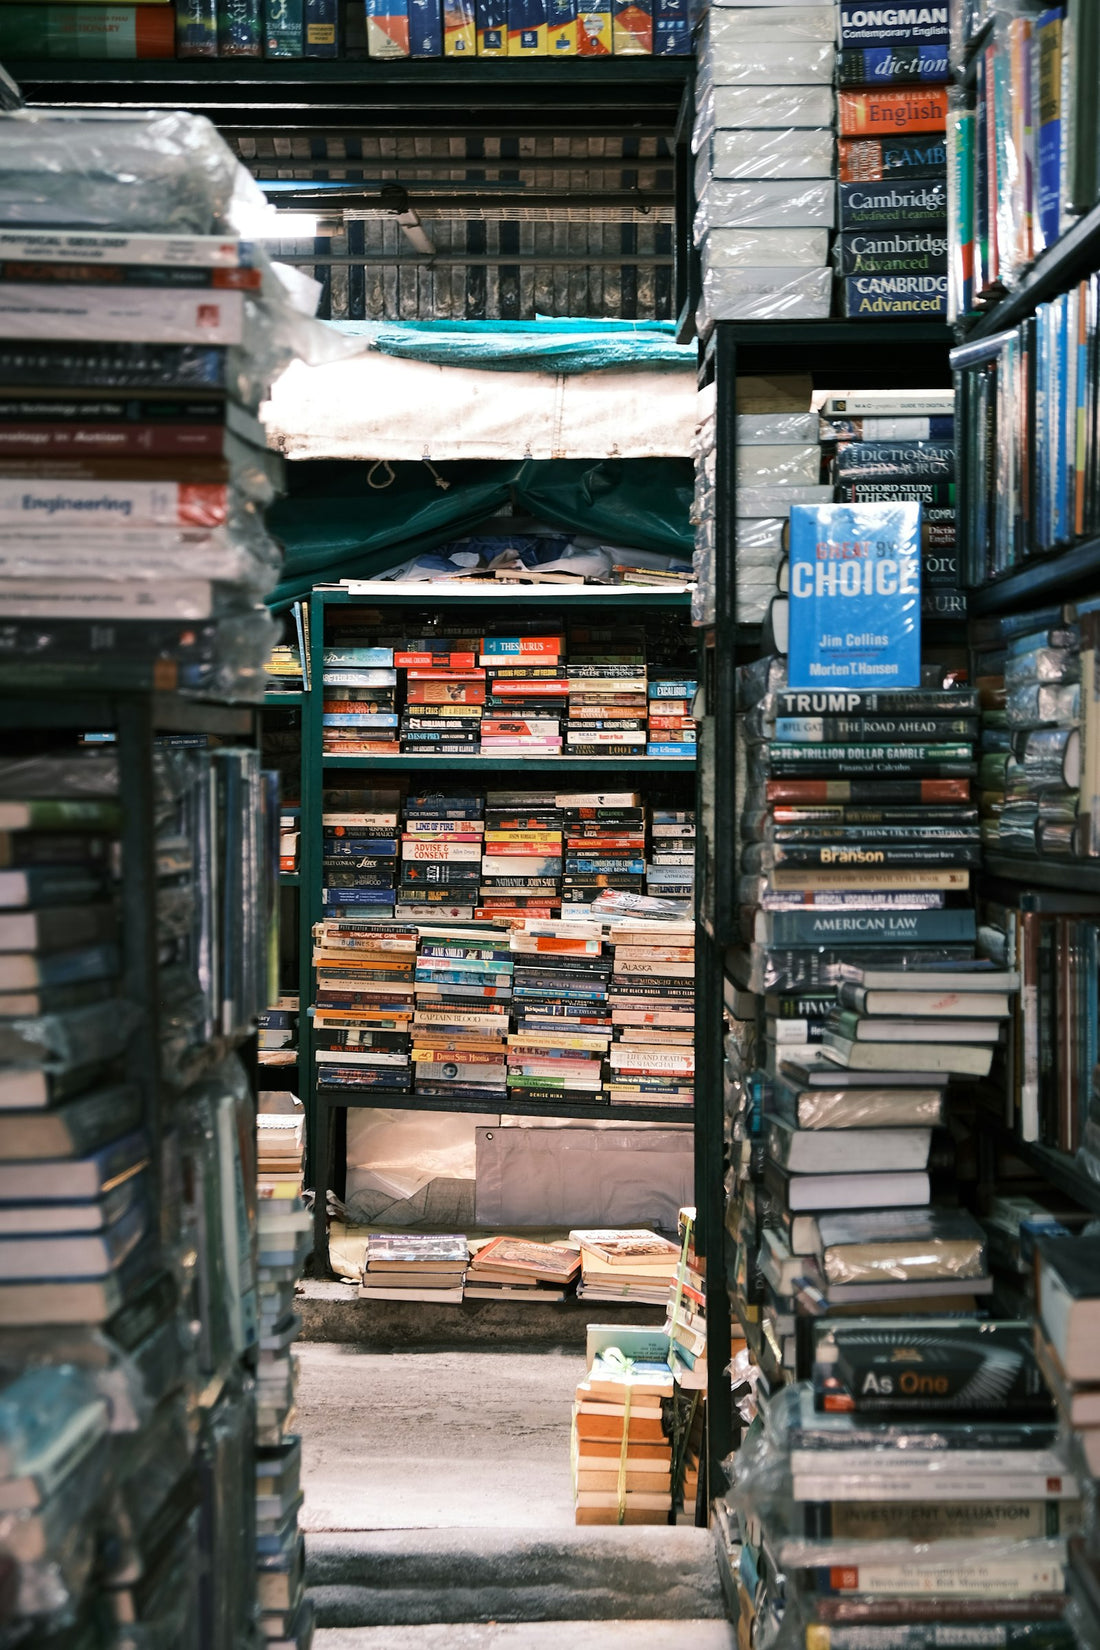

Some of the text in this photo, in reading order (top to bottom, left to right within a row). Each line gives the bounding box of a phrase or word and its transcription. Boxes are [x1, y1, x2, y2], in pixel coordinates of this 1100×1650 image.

[842, 8, 948, 27] LONGMAN
[843, 27, 948, 38] Contemporary English
[868, 92, 940, 102] MACMILLAN
[869, 101, 942, 126] English
[849, 189, 946, 211] Cambridge
[851, 210, 898, 222] Advanced
[851, 234, 948, 256] Cambridge
[854, 255, 928, 272] Advanced
[856, 276, 946, 294] CAMBRIDG
[859, 298, 940, 312] Advanced
[74, 432, 126, 442] Action
[862, 448, 955, 461] DICTIONARY
[856, 492, 933, 502] THESAURUS
[22, 496, 132, 514] Engineering
[816, 542, 870, 560] GREAT
[792, 559, 919, 598] CHOICE
[500, 642, 544, 650] THESAURUS
[820, 633, 888, 647] Jim Collins
[810, 663, 849, 676] Morten
[858, 662, 898, 674] Hansen
[657, 687, 686, 696] EXCALIBUR
[783, 694, 861, 713] TRUMP
[838, 722, 860, 732] THE
[864, 722, 895, 732] ROAD
[898, 722, 936, 732] AHEAD
[609, 746, 631, 754] LOOT
[848, 748, 884, 760] DOLLAR
[887, 748, 925, 760] GAMBLE
[839, 763, 910, 772] Financial Calculus
[416, 823, 430, 831] LINE
[356, 857, 377, 868] Lace
[820, 850, 884, 863] Branson
[814, 918, 917, 931] AMERICAN LAW
[431, 948, 494, 959] JANE SMILEY MOO
[621, 963, 652, 971] ALASKA
[862, 1371, 948, 1394] As One
[844, 1504, 1030, 1521] INVESTMENT VALUATION
[924, 1579, 931, 1588] &
[936, 1578, 953, 1588] Risk
[959, 1579, 1018, 1590] Management
